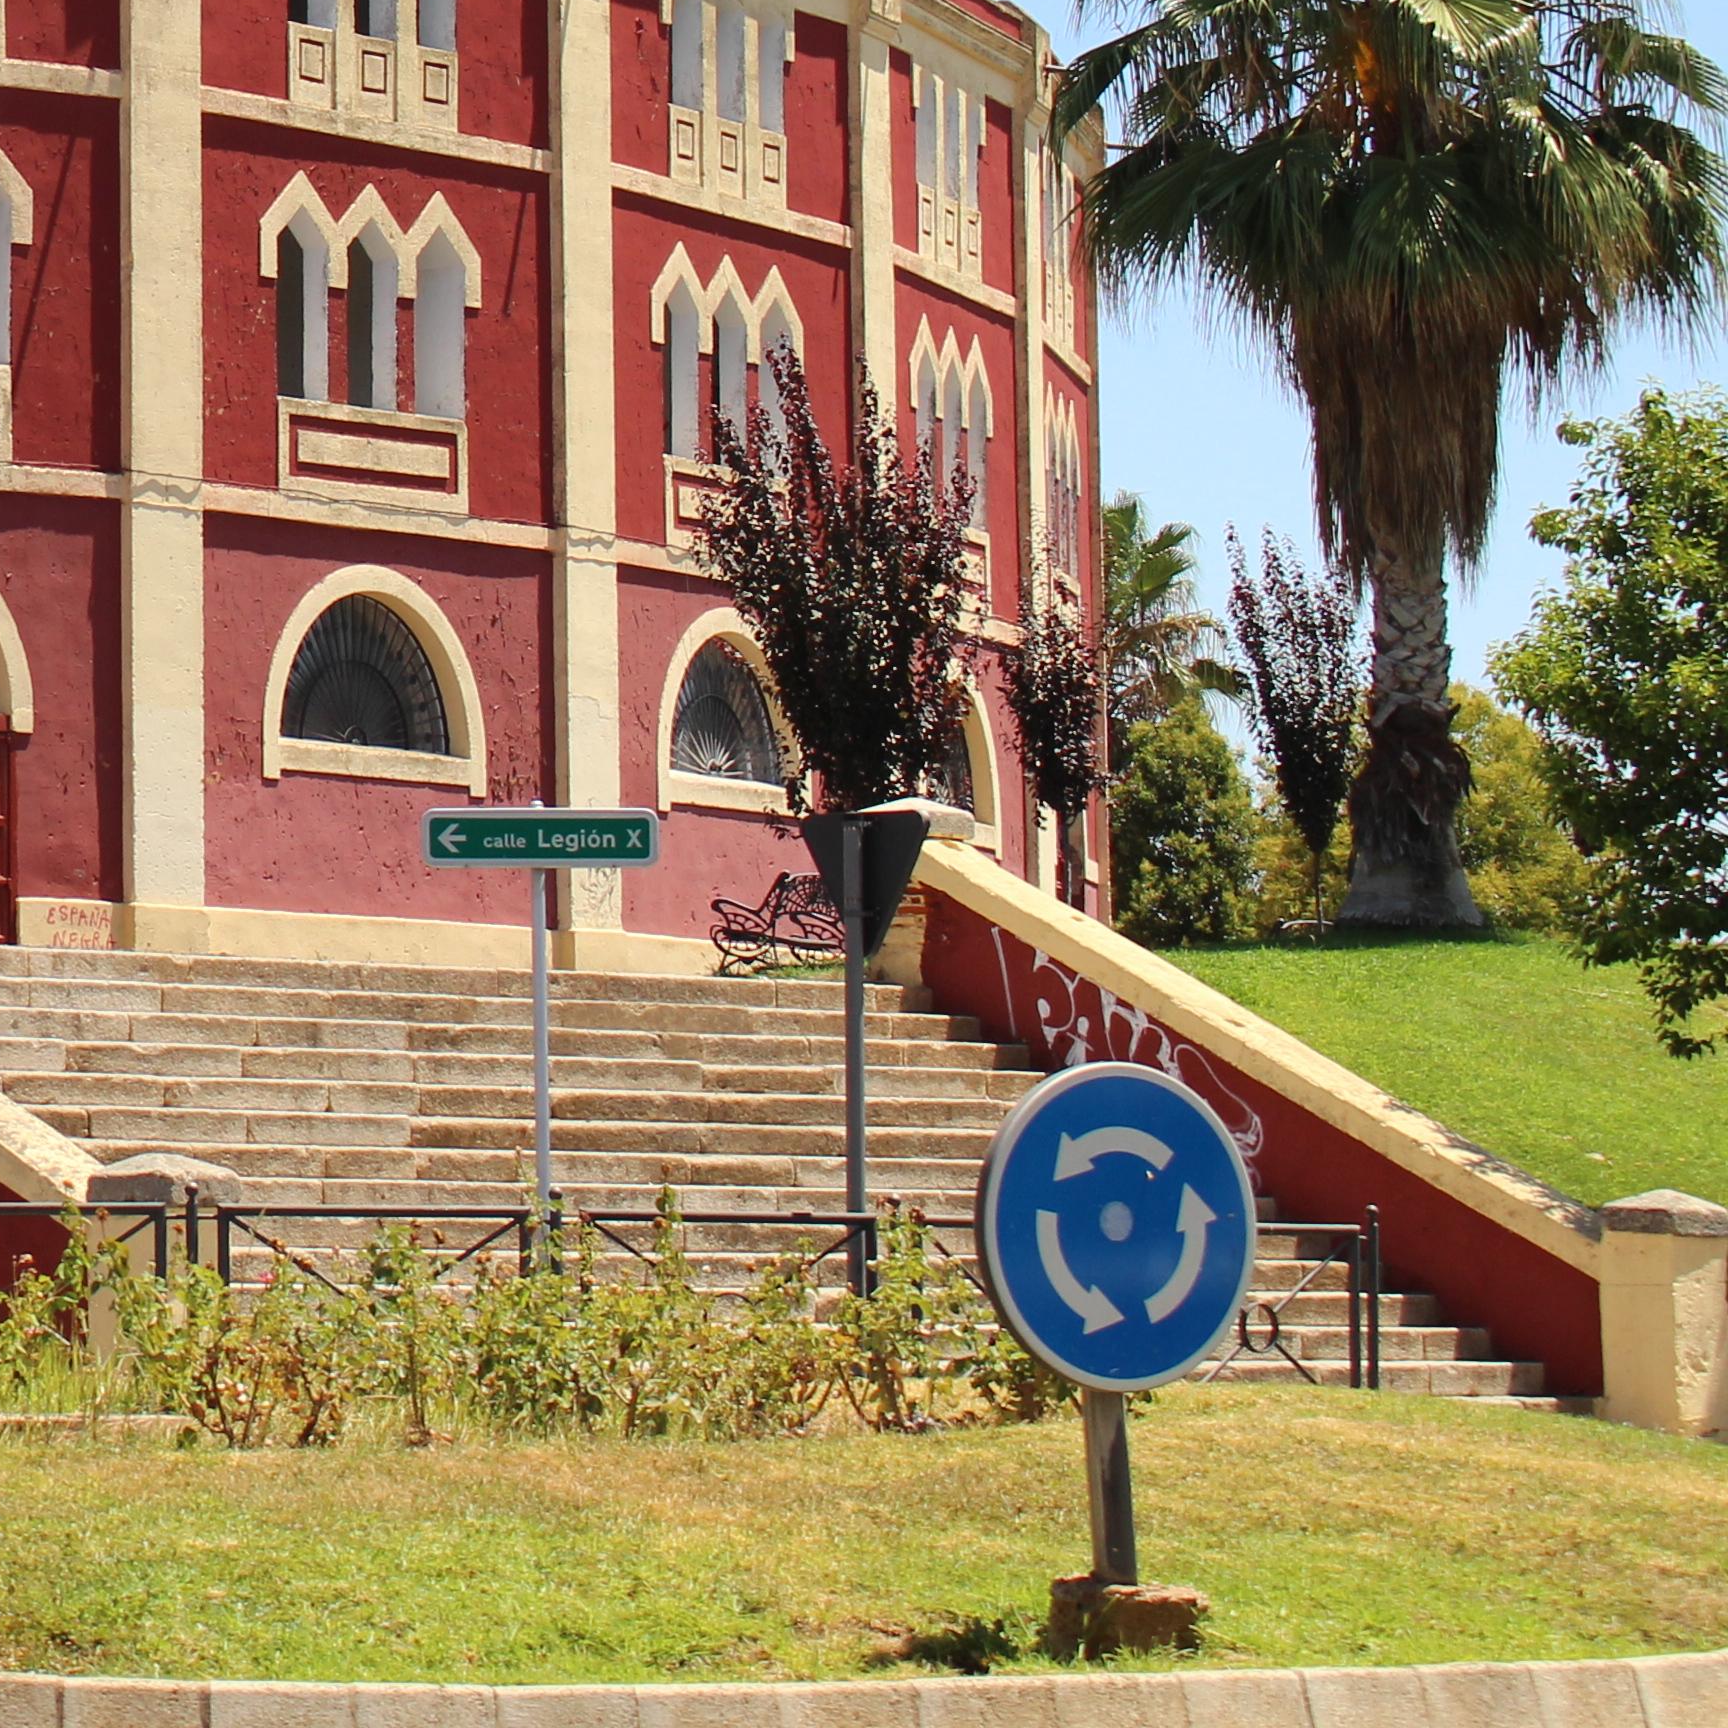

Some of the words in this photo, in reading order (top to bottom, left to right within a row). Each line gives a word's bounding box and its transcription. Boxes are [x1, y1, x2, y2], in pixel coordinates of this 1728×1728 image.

[483, 835, 526, 849] calle
[538, 829, 616, 852] Legión
[626, 829, 644, 848] X
[46, 905, 111, 929] ESPAÑA
[52, 931, 117, 950] NEGRA
